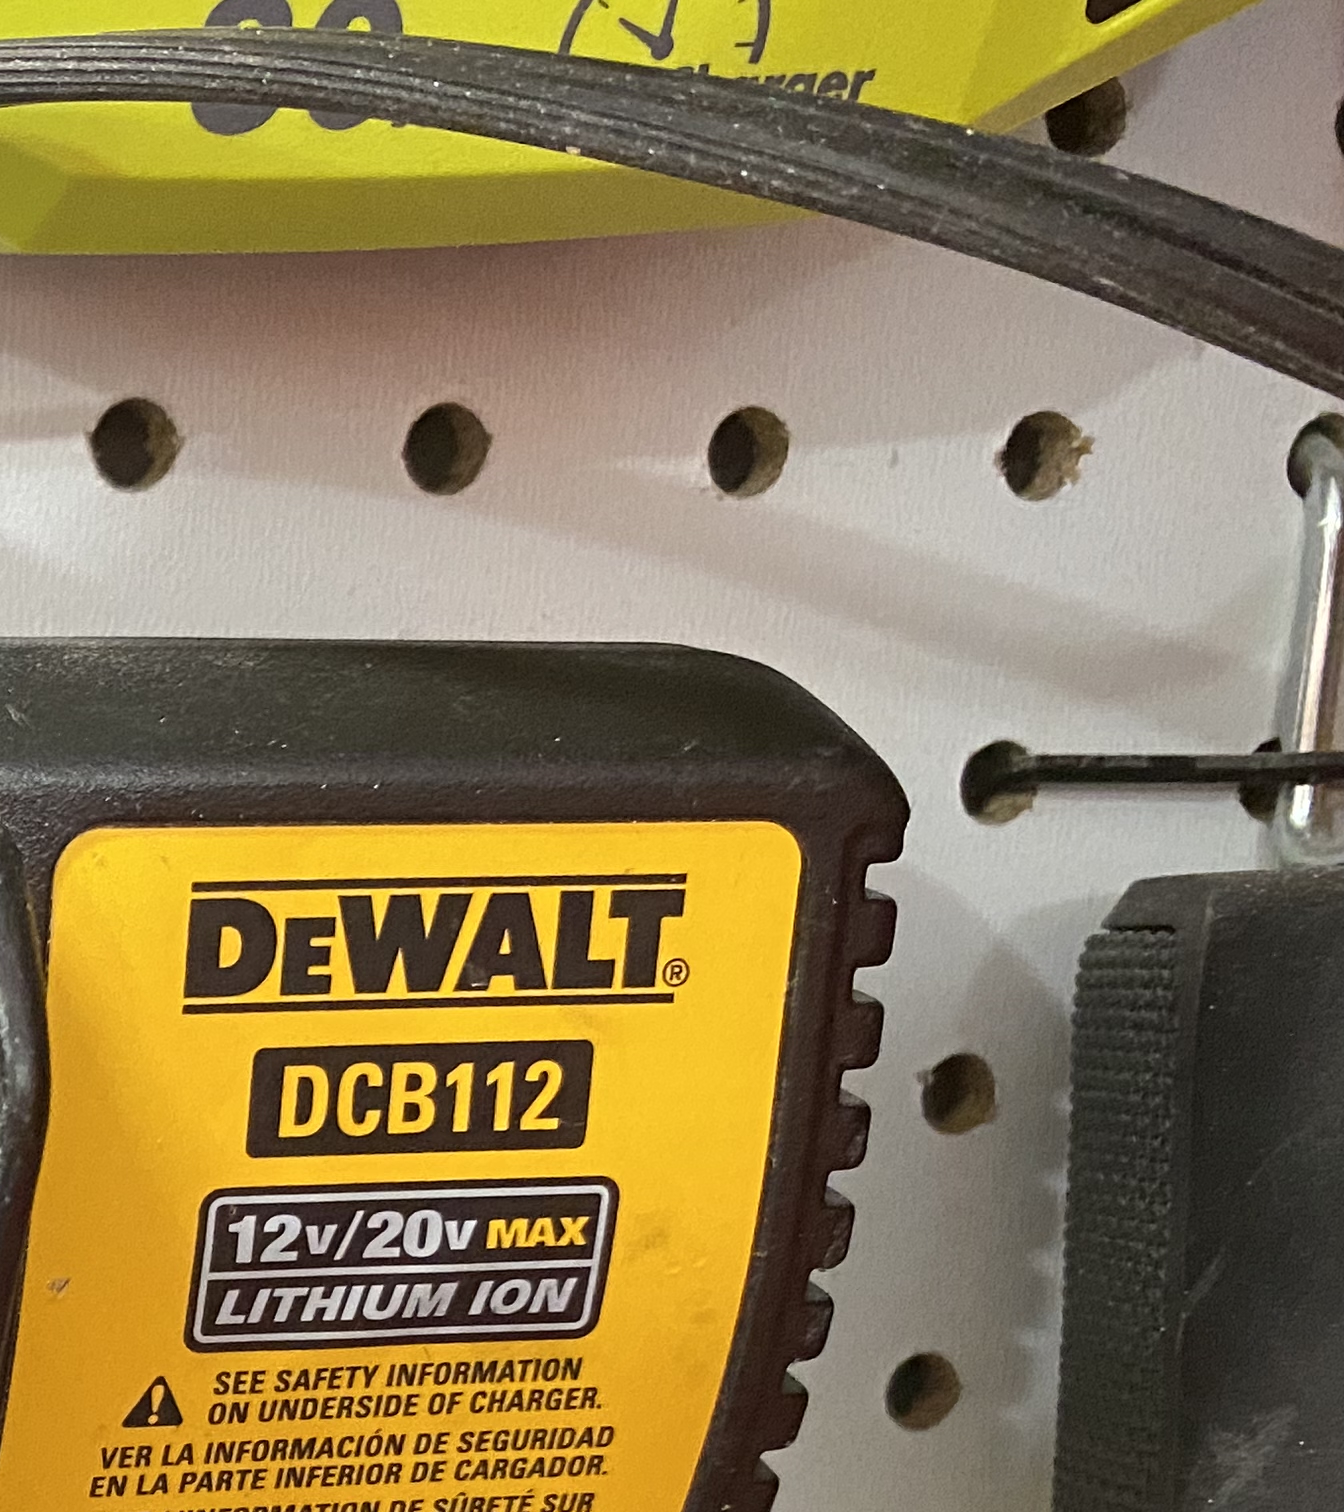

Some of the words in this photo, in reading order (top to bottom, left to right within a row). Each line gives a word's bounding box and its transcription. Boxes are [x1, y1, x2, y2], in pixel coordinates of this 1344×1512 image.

[183, 889, 686, 999] DEWALT
[277, 1059, 563, 1138] DCB112
[485, 1216, 587, 1250] MAX
[216, 1282, 462, 1326] LITHIUM
[467, 1277, 577, 1316] ION
[213, 1370, 269, 1395] SEE
[274, 1366, 378, 1392] SAFETY
[385, 1358, 583, 1387] INFORMATION
[207, 1401, 250, 1425] ON
[258, 1393, 418, 1422] UNDERSIDE
[429, 1392, 464, 1416] OF
[469, 1387, 603, 1414] CHARGER.
[100, 1446, 153, 1469] VER
[162, 1444, 195, 1467] LA
[204, 1430, 408, 1464] INFORMACIÓN
[414, 1432, 450, 1455] DE
[455, 1426, 614, 1454] SEGURIDAD
[90, 1475, 127, 1498] EN
[135, 1473, 169, 1496] LA
[179, 1466, 267, 1493] PARTE
[273, 1462, 403, 1489] INFERIOR
[410, 1460, 447, 1483] DE
[454, 1454, 609, 1480] CARGADOR.
